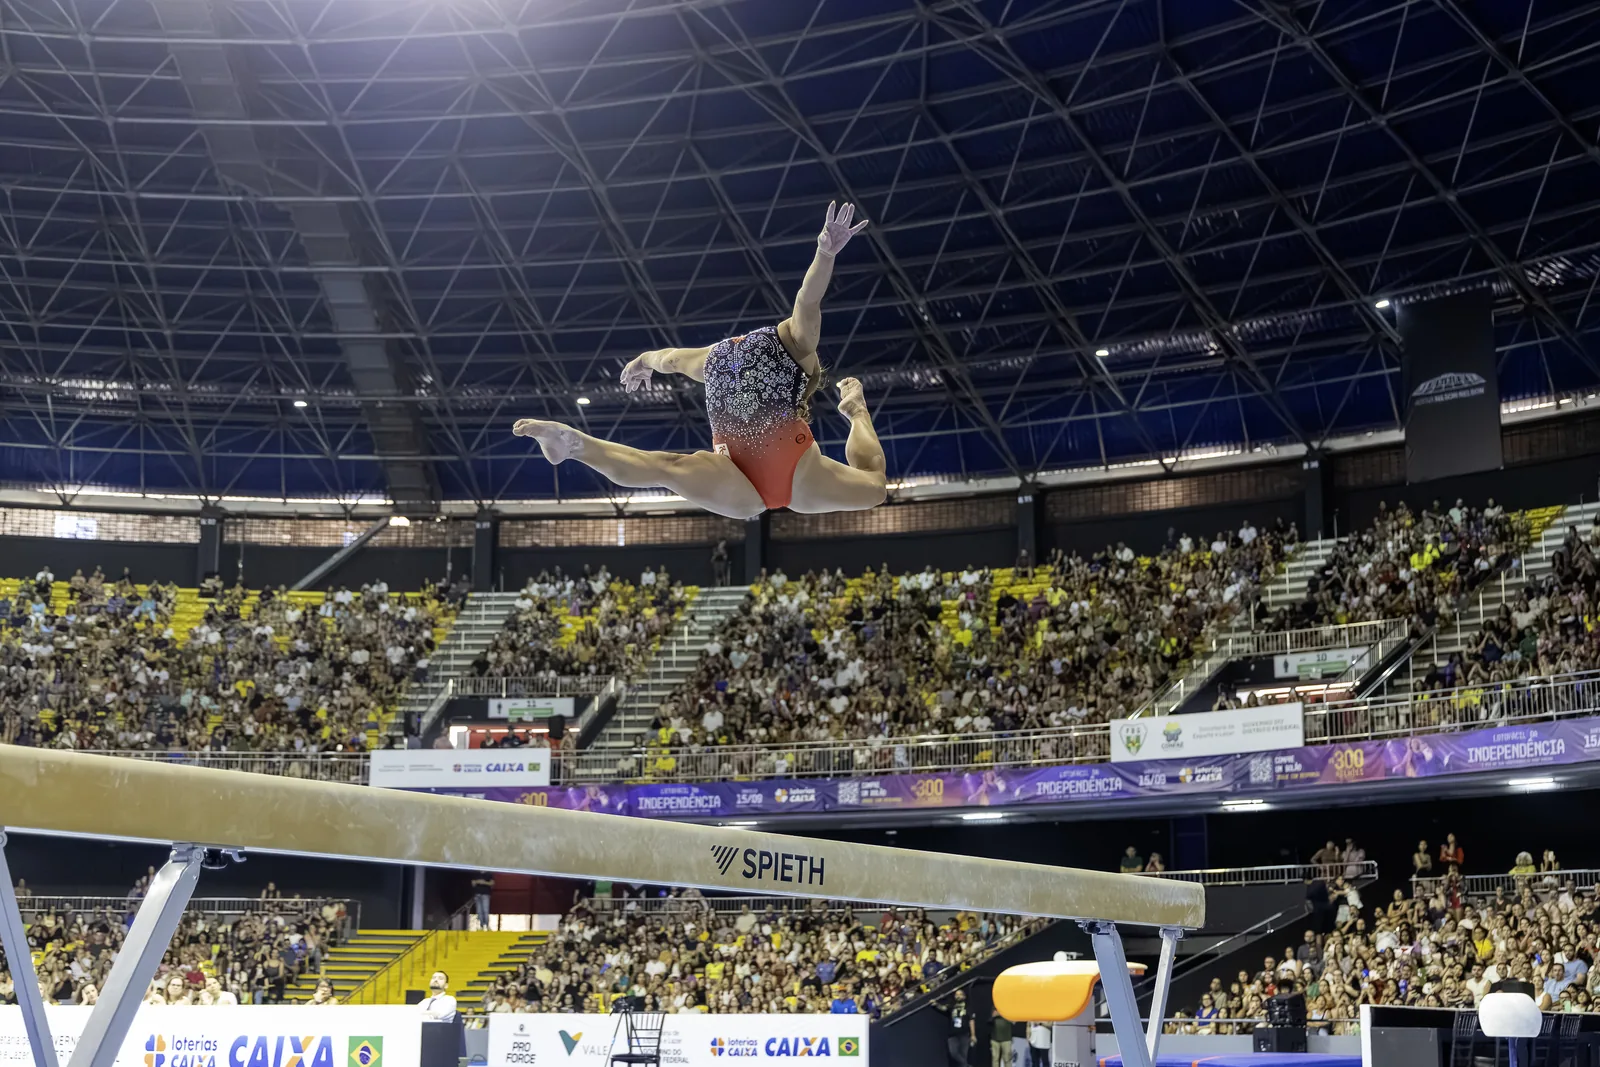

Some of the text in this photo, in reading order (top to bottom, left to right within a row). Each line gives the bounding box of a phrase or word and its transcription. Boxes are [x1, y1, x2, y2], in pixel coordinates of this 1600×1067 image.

[1334, 749, 1364, 770] 300
[1467, 739, 1566, 763] INDEPENDÊNCIA
[485, 763, 524, 772] CAIXA
[916, 779, 943, 797] 300
[1036, 775, 1123, 795] INDEPENDÊNCIA
[638, 793, 721, 810] INDEPENDÊNCIA
[736, 793, 763, 804] 15/09
[742, 848, 825, 886] SPIETH
[172, 1035, 218, 1052] loterias
[512, 1042, 531, 1052] PRO
[728, 1037, 757, 1046] loterias
[765, 1037, 831, 1057] CAIXA
[229, 1035, 335, 1067] CAIXA
[506, 1053, 537, 1064] FORCE
[583, 1045, 609, 1056] VALE
[728, 1047, 758, 1057] CAIXA
[171, 1055, 216, 1067] CAIXA
